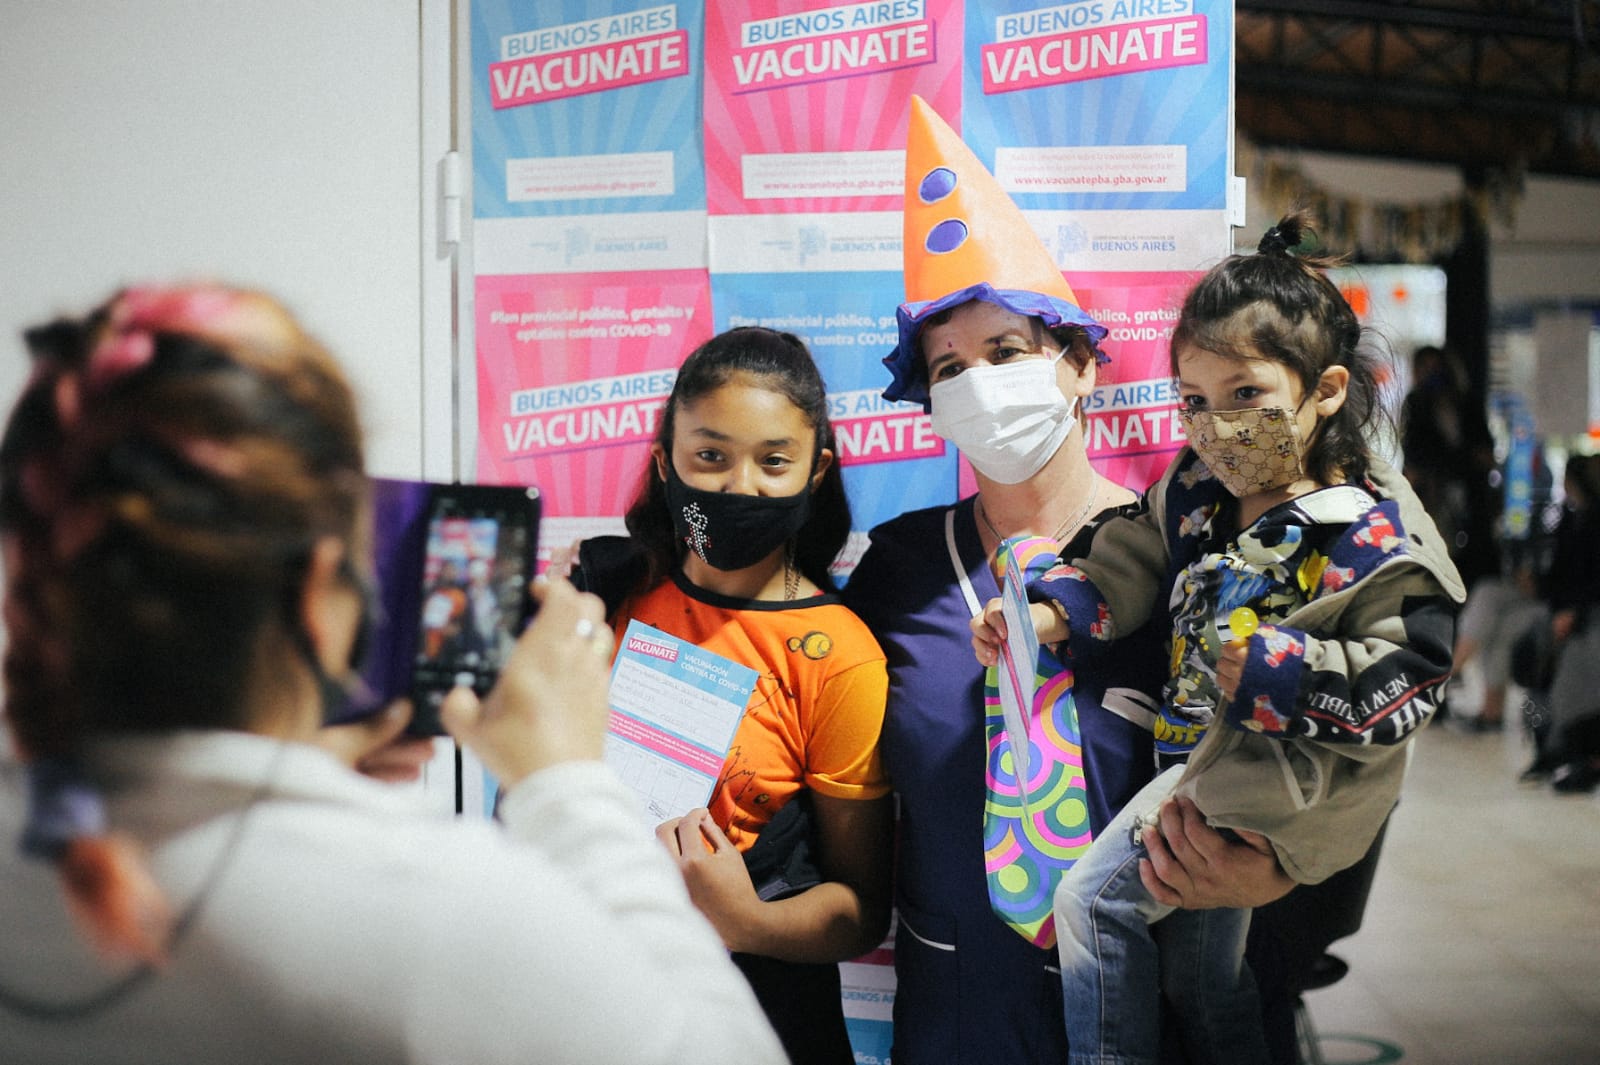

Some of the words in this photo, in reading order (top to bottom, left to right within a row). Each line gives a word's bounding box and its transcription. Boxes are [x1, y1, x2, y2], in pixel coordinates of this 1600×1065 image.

[507, 26, 600, 57] BUENOS
[607, 9, 673, 39] AIRES
[748, 11, 844, 44] BUENOS
[852, 1, 919, 27] AIRES
[1003, 6, 1104, 38] BUENOS
[1111, 0, 1187, 20] AIRES
[492, 35, 681, 100] VACUNATE
[732, 24, 928, 85] VACUNATE
[986, 21, 1198, 84] VACUNATE
[1092, 241, 1138, 251] BUENOS
[1141, 241, 1176, 251] AIRES
[760, 314, 823, 329] provincial
[814, 334, 853, 346] contra
[516, 385, 600, 413] BUENOS
[609, 373, 673, 399] AIRES
[503, 402, 663, 452] VACUNAT
[835, 416, 936, 457] NATE
[1087, 409, 1188, 451] NATE
[628, 639, 677, 660] VACUNATE
[681, 662, 708, 678] CONTRA
[709, 673, 717, 683] EL
[1372, 672, 1410, 709] NEW
